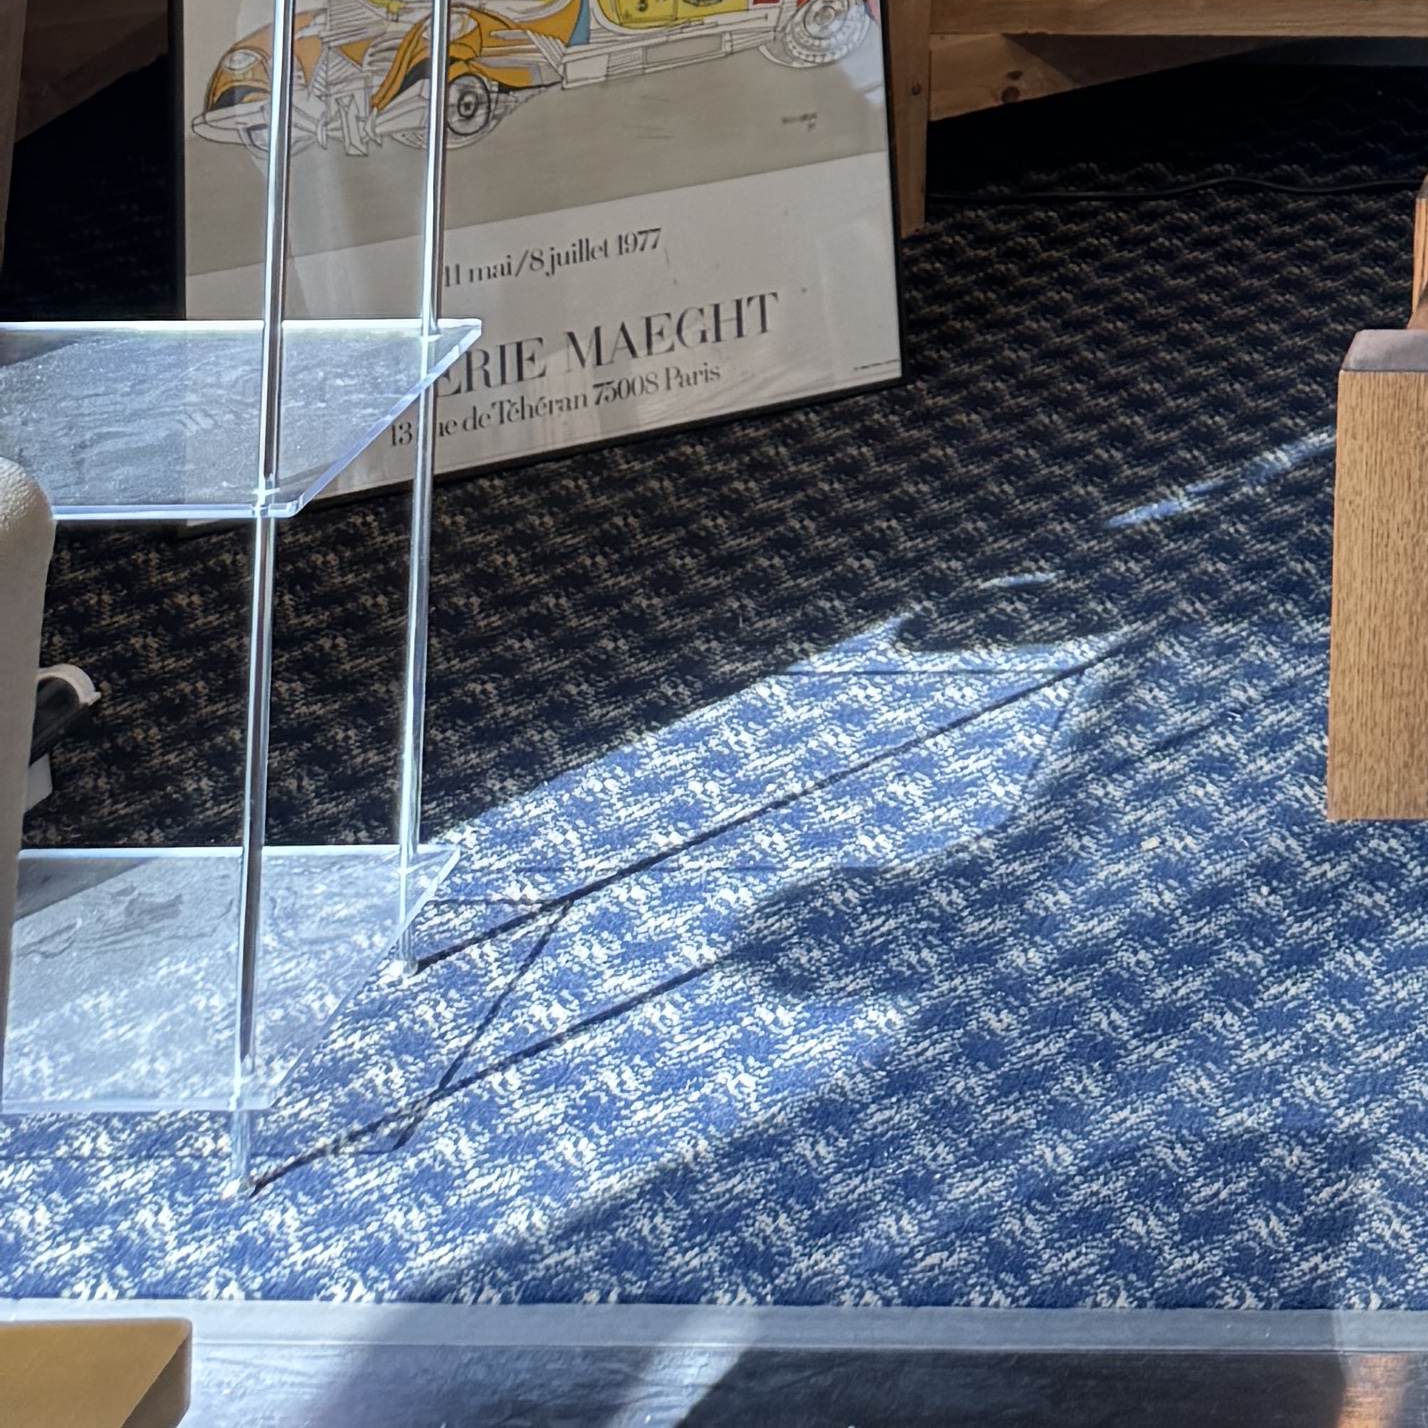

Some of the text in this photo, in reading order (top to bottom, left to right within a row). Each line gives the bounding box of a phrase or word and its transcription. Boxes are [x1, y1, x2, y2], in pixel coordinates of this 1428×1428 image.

[546, 238, 609, 277] juillet
[617, 227, 661, 256] 1977
[437, 292, 779, 398] ERIE MAEGHT
[391, 422, 413, 445] 13
[462, 404, 491, 431] de
[664, 361, 721, 392] Paris
